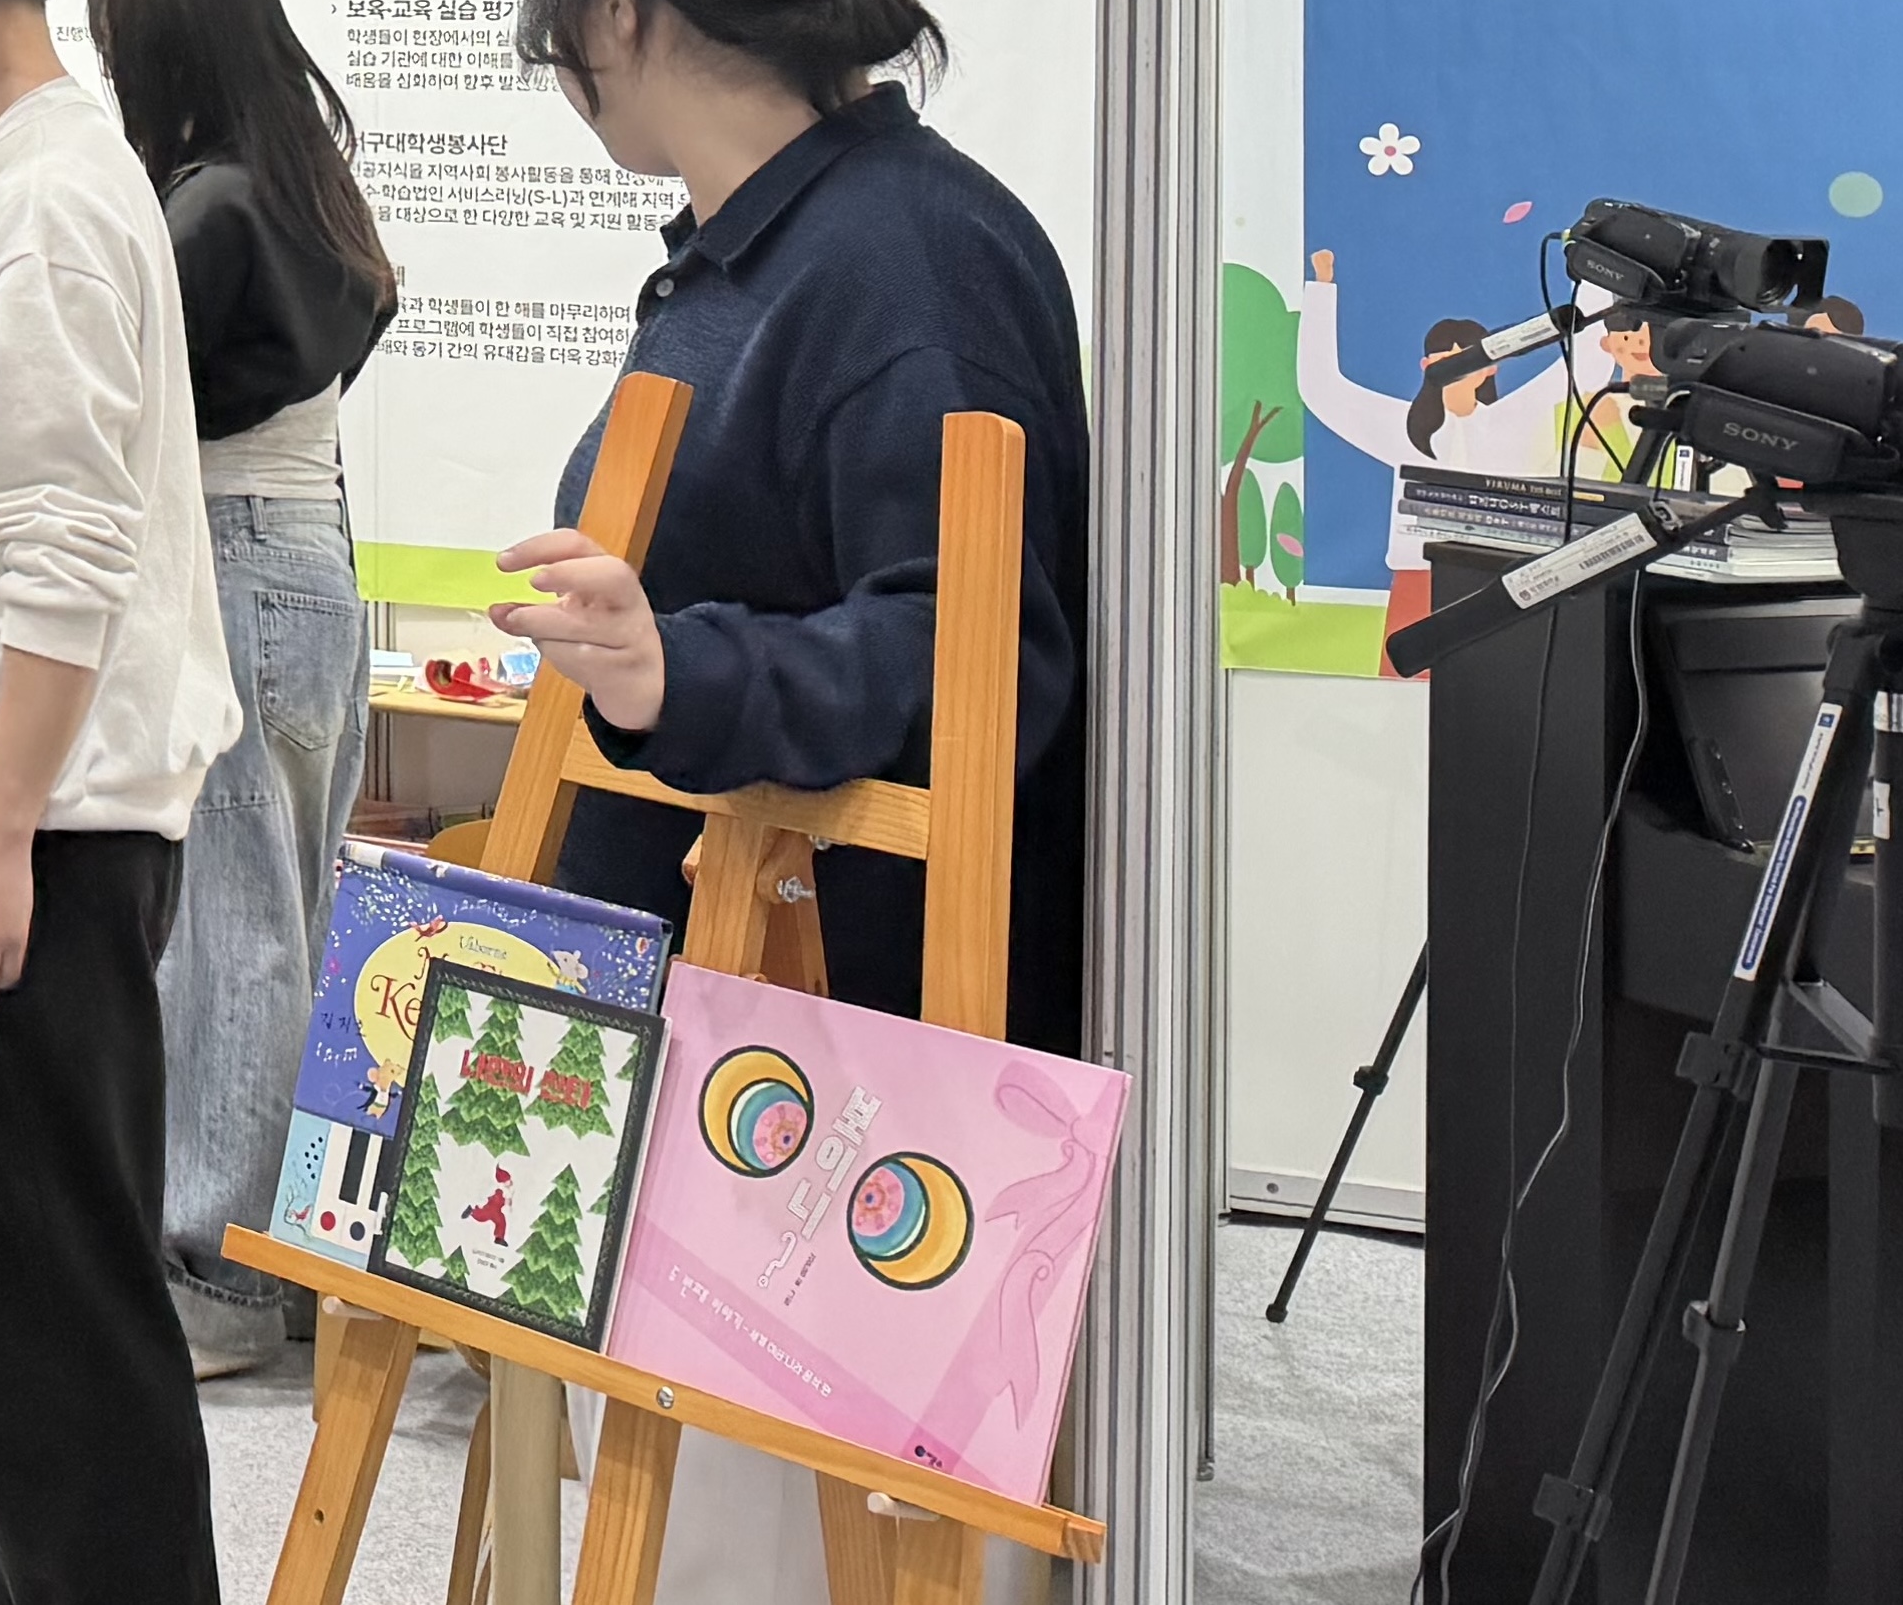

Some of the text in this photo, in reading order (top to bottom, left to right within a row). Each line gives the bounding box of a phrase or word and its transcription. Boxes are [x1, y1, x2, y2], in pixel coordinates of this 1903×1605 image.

[438, 0, 476, 20] 실습
[348, 29, 490, 46] 학생들이 현장에서의
[1586, 259, 1625, 282] SONY
[550, 303, 630, 323] 마무리하며
[396, 319, 473, 337] 프로그램에
[1723, 422, 1798, 451] SONY
